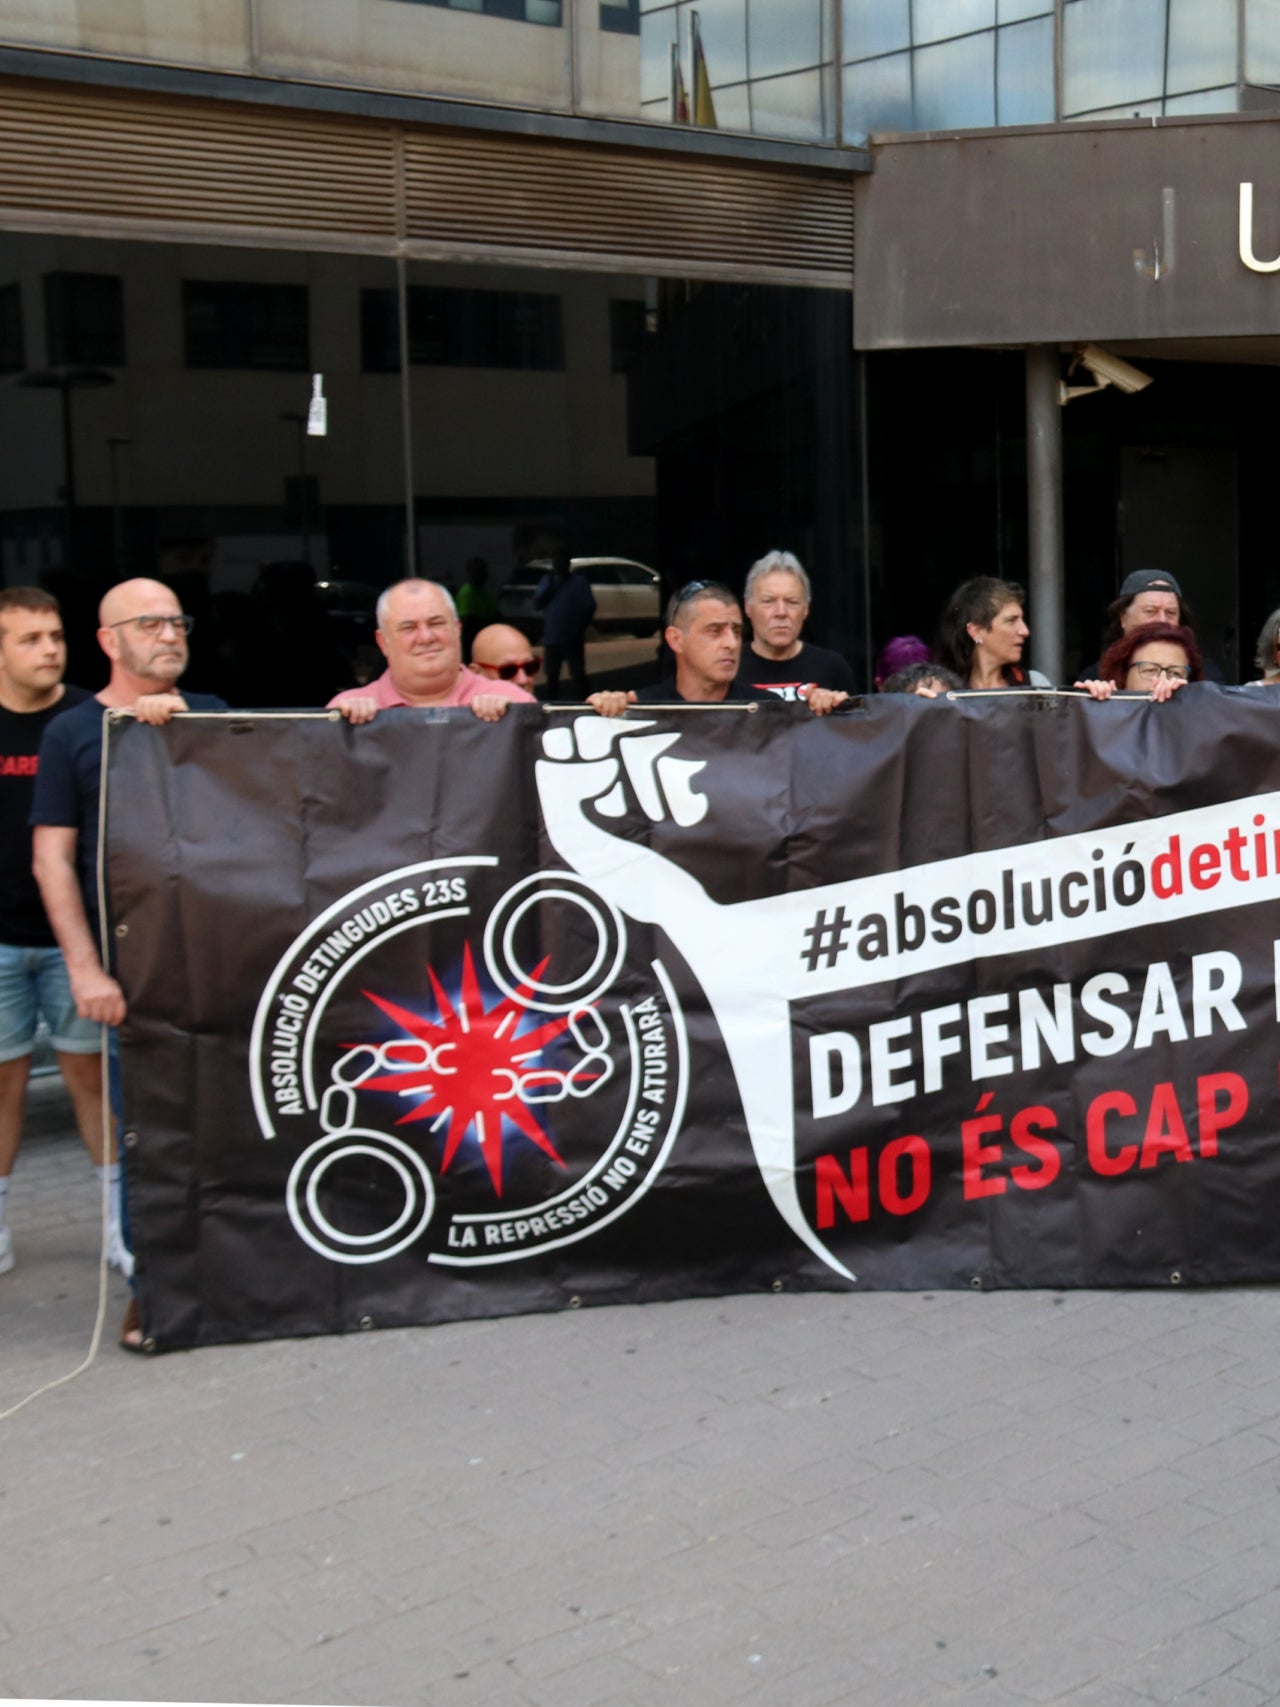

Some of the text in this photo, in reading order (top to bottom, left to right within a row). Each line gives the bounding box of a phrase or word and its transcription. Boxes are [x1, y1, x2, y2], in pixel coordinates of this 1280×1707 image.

[270, 877, 468, 1115] ABSOLUCIÓ DETINGUDES 23S
[809, 950, 1247, 1118] DEFENSAR
[447, 1225, 476, 1248] LA
[484, 1184, 610, 1245] REPRESSIÓ
[602, 1156, 638, 1191] NO
[624, 1109, 661, 1157] ENS
[814, 1133, 931, 1230] NO
[961, 1092, 1061, 1201] ÉS
[1086, 1071, 1249, 1175] CAP
